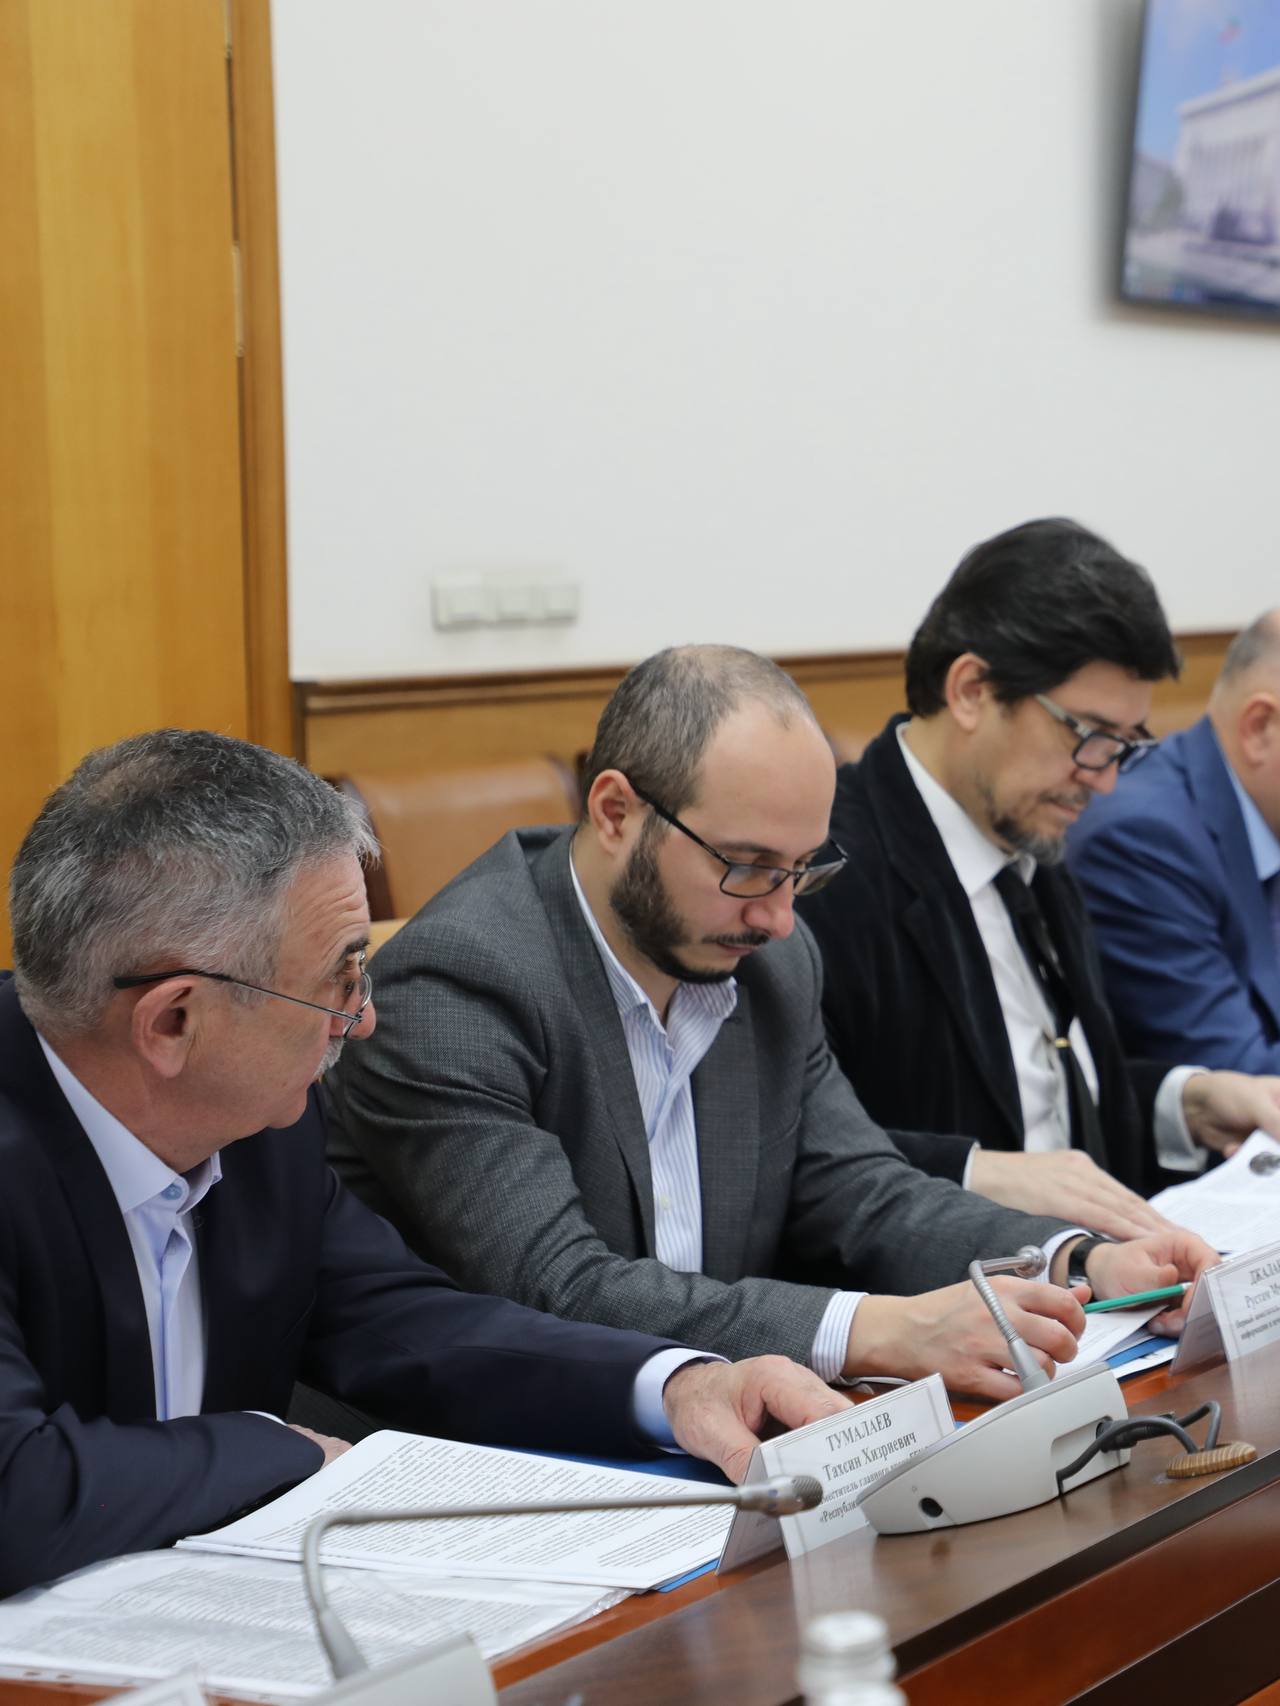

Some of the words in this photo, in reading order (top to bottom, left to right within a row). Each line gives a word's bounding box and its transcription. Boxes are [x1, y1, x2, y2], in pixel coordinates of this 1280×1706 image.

[825, 1412, 892, 1452] ТУМАЛАЕВ
[822, 1456, 862, 1481] Тахсин
[860, 1431, 917, 1465] Хизриевич
